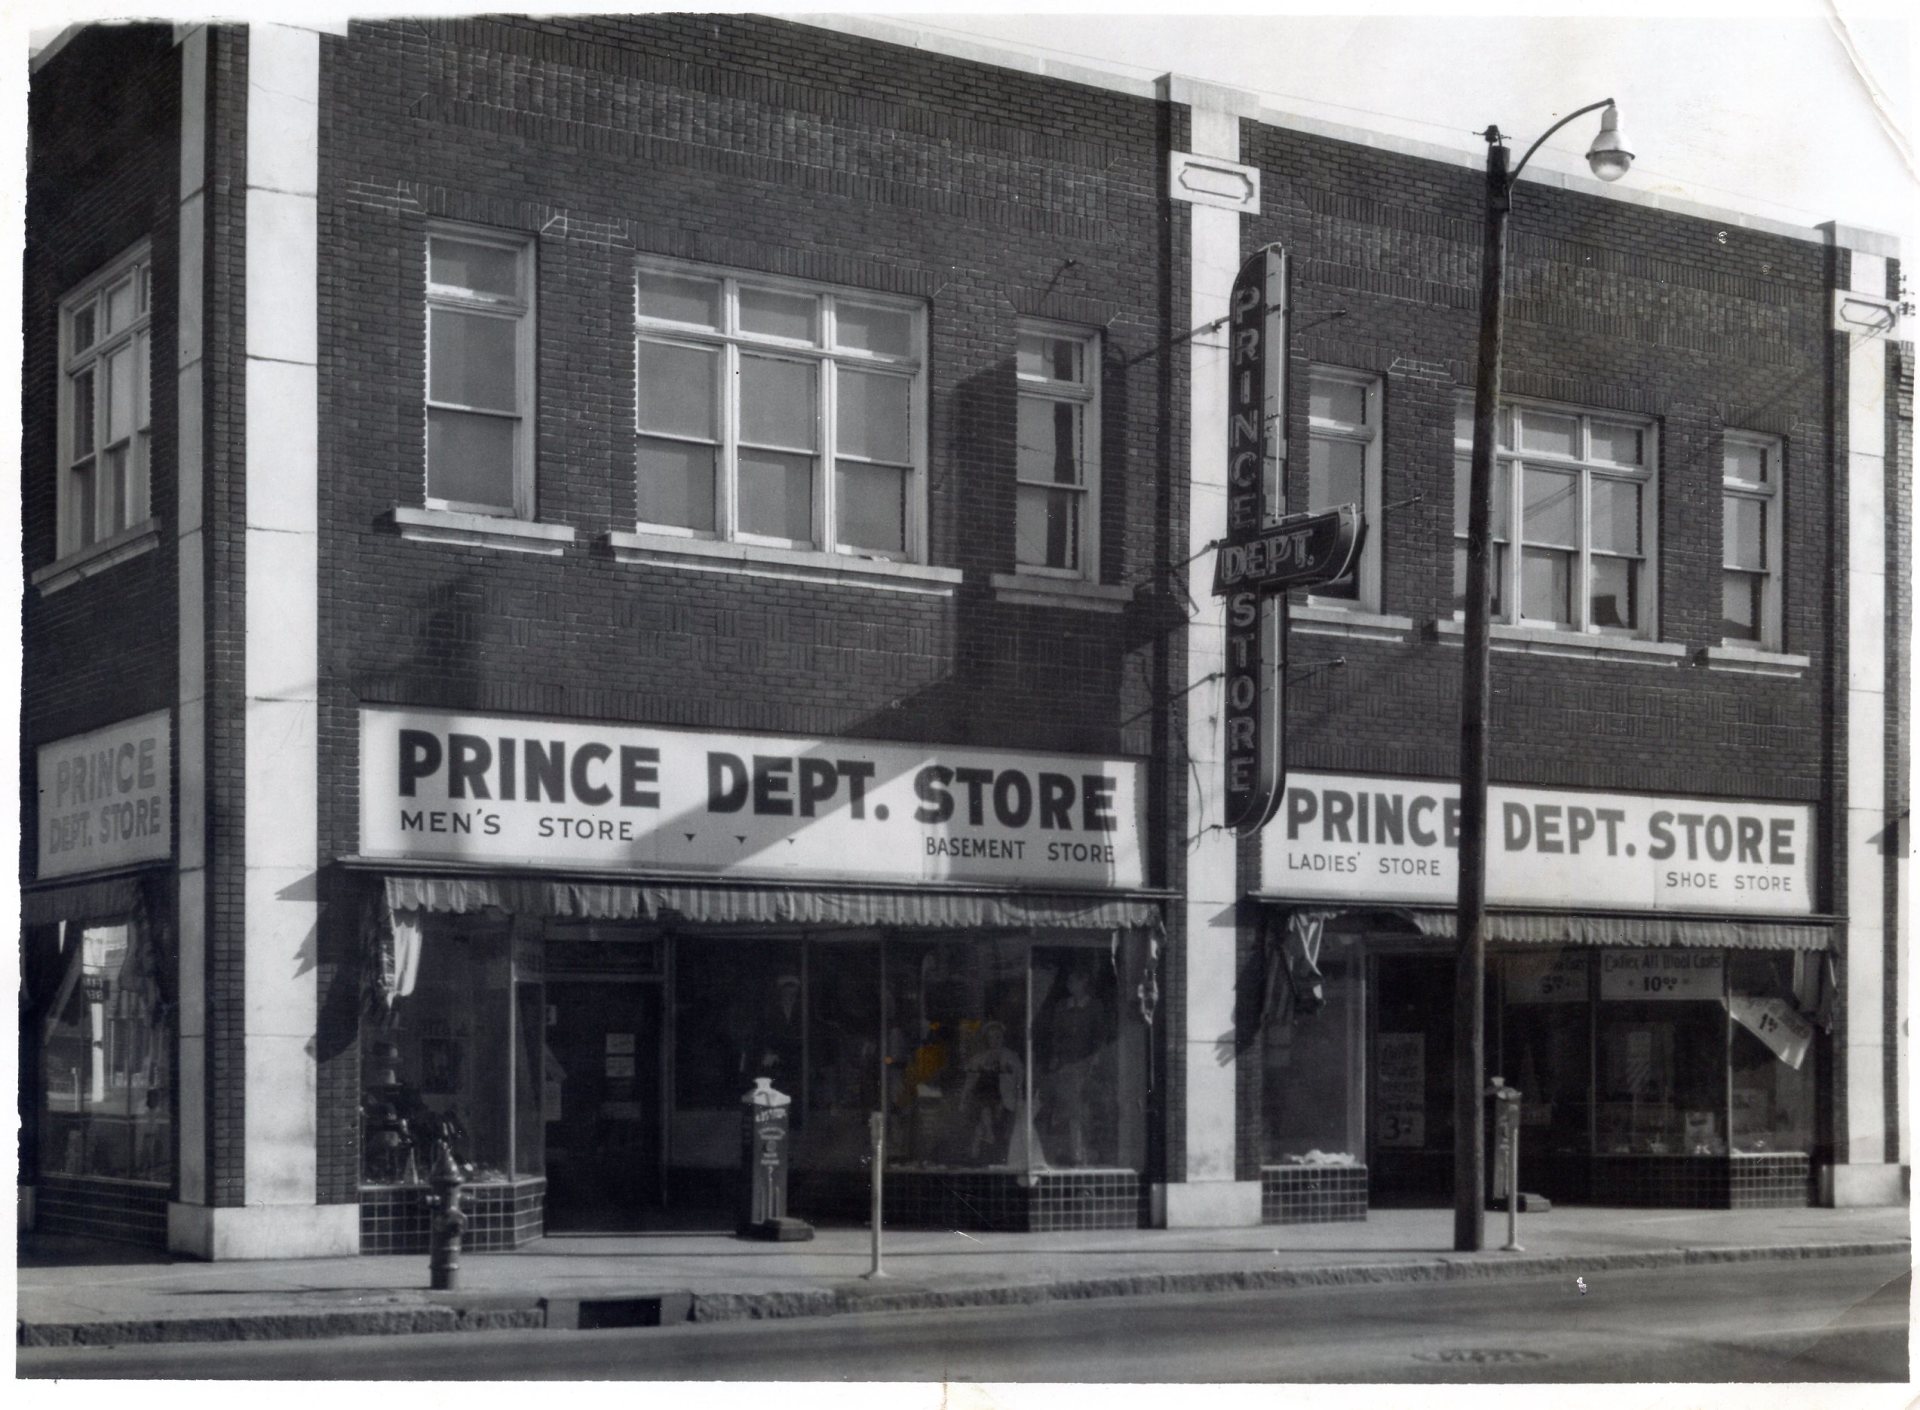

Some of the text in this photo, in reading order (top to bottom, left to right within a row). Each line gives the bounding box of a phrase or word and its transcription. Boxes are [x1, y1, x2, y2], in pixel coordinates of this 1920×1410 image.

[1230, 285, 1261, 530] PRINCE
[1221, 528, 1316, 585] DEPT.
[1229, 591, 1257, 792] STORE
[56, 737, 157, 808] PRINCE
[398, 728, 1118, 832] PRINCE DEPT. STORE
[49, 795, 162, 855] DEPT. STORE
[401, 808, 635, 842] MEN'S STORE
[925, 836, 1116, 864] BASEMENT STORE
[1287, 787, 1796, 866] PRINCE DEPT. STORE
[1288, 851, 1441, 876] LADIES' STORE
[1666, 872, 1793, 892] SHOE STORE
